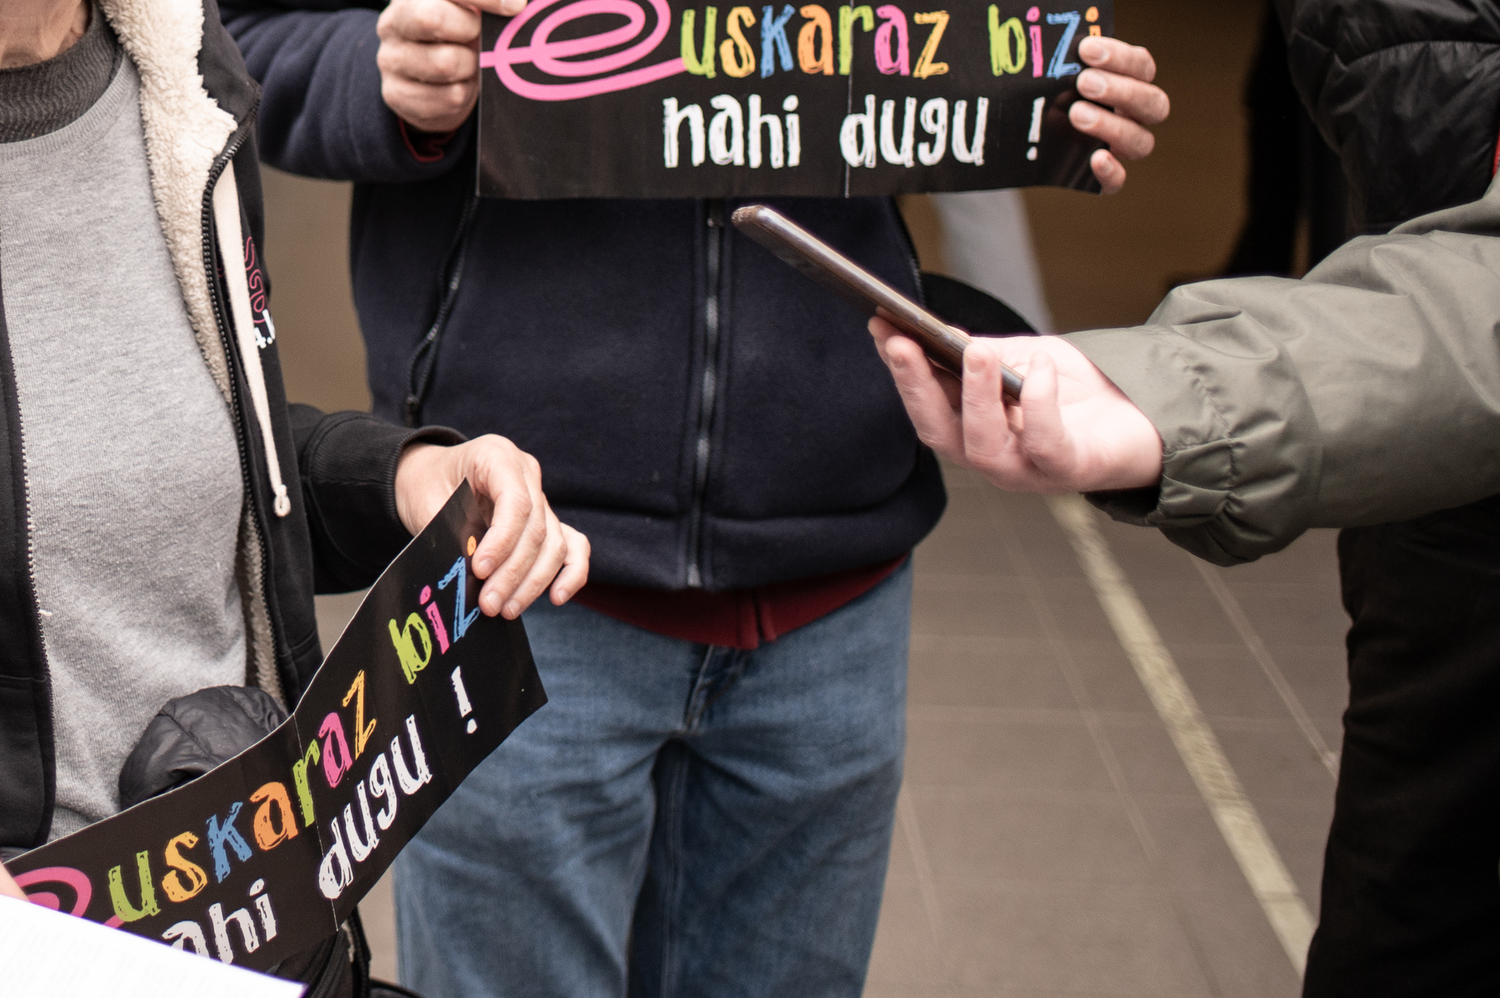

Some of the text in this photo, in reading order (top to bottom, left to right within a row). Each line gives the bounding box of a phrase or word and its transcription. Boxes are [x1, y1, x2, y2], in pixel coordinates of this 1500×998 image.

[662, 93, 1046, 169] nahi dugu !
[388, 535, 481, 684] biz
[162, 878, 277, 965] ahi
[318, 714, 432, 899] dugu
[450, 665, 477, 735] !
